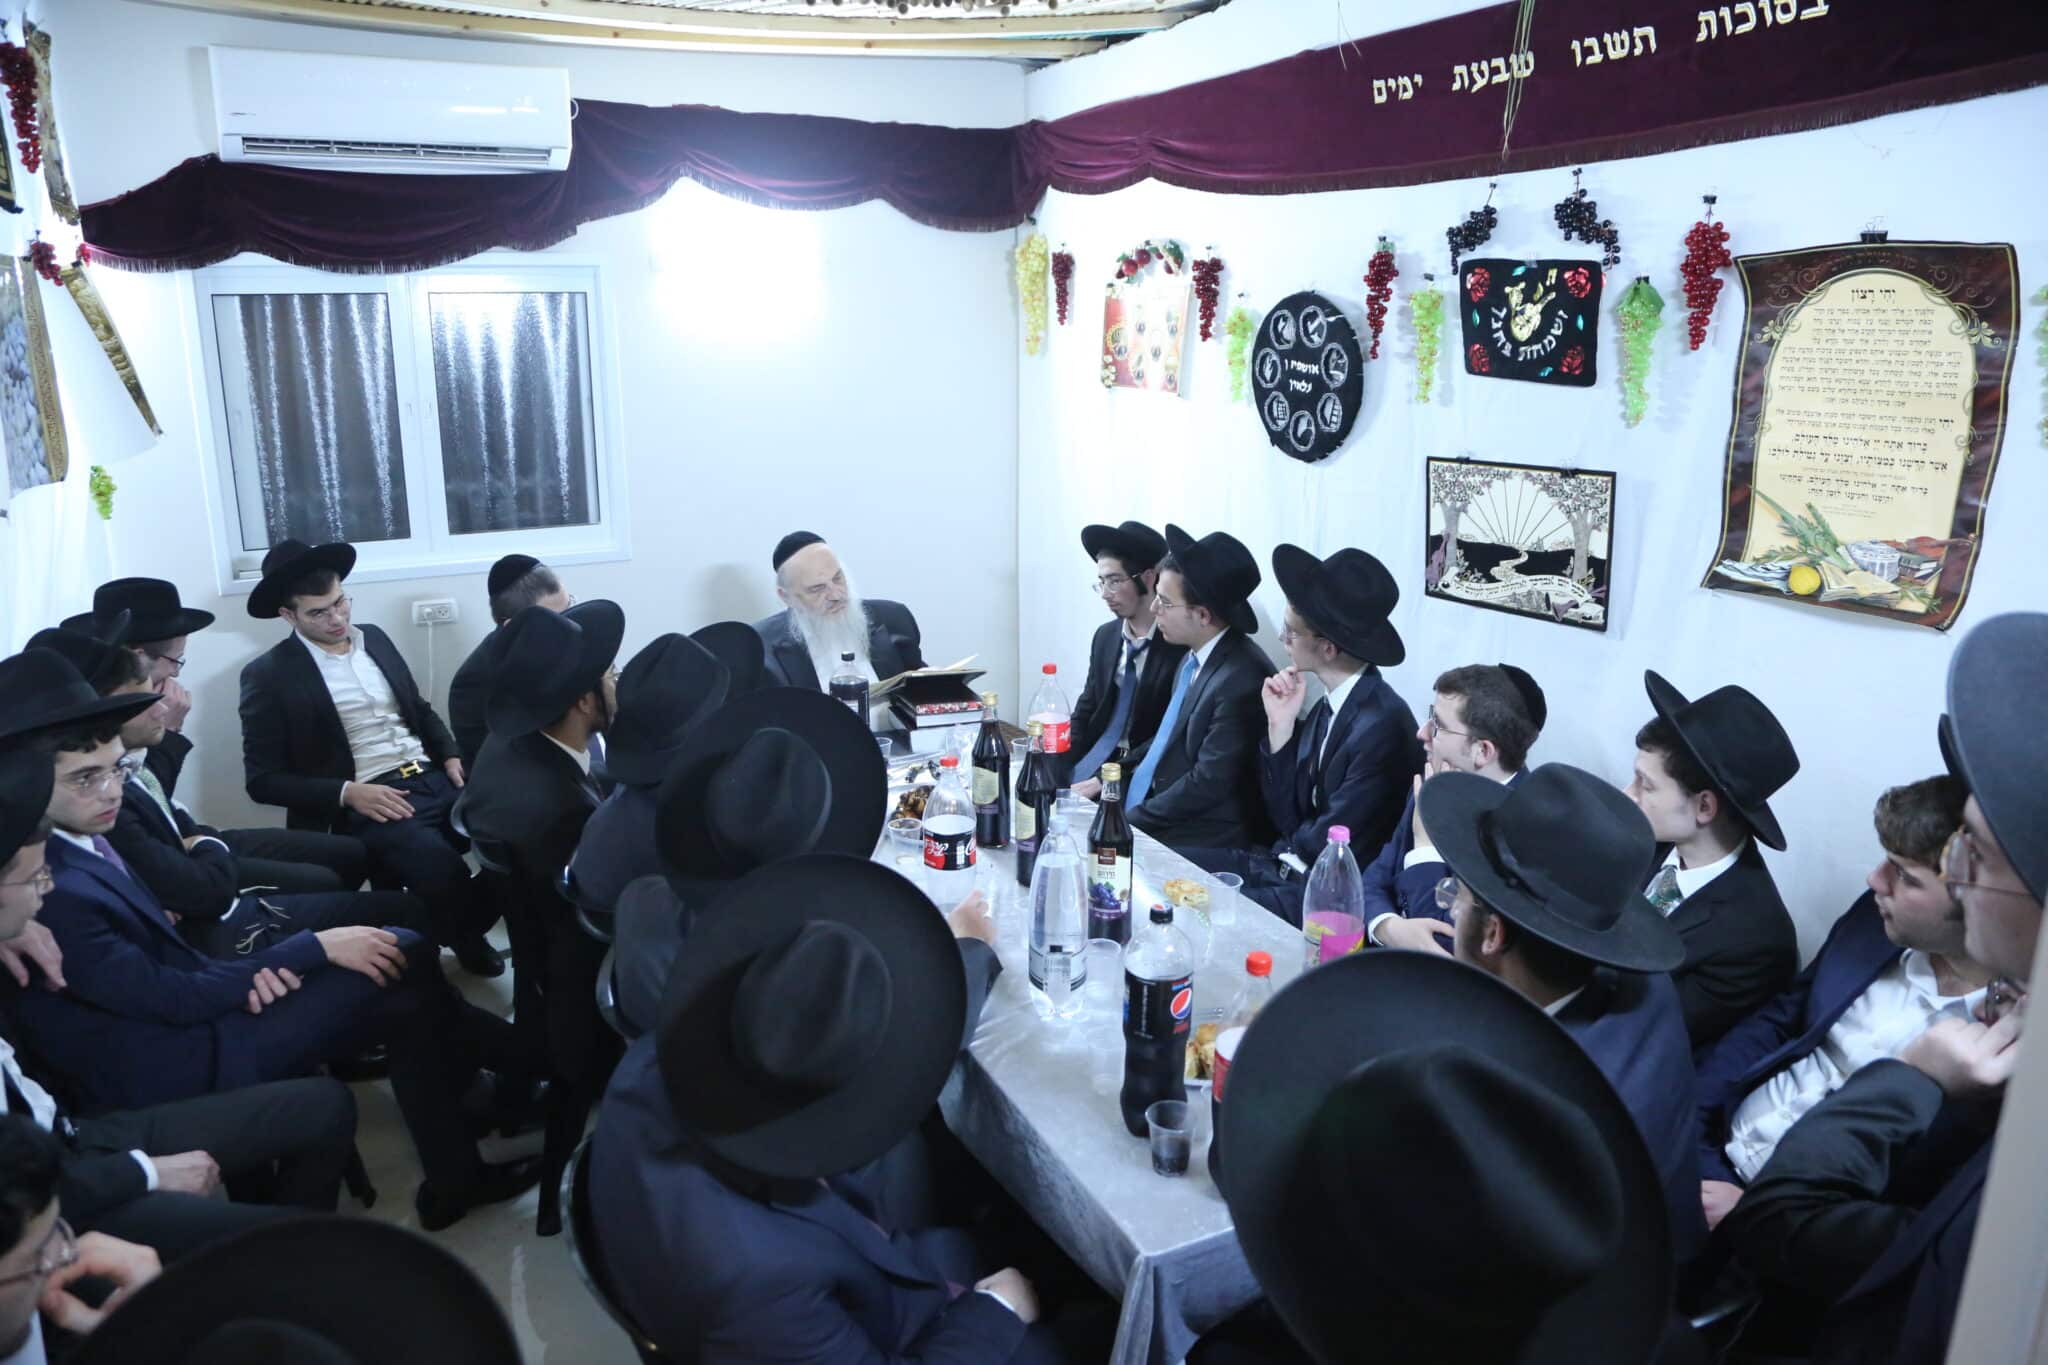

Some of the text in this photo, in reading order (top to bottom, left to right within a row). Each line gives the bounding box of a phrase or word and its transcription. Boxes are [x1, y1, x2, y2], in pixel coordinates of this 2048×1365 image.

[1571, 24, 1657, 68] תשבו
[1372, 72, 1423, 104] ימים
[1451, 50, 1535, 93] שבעת
